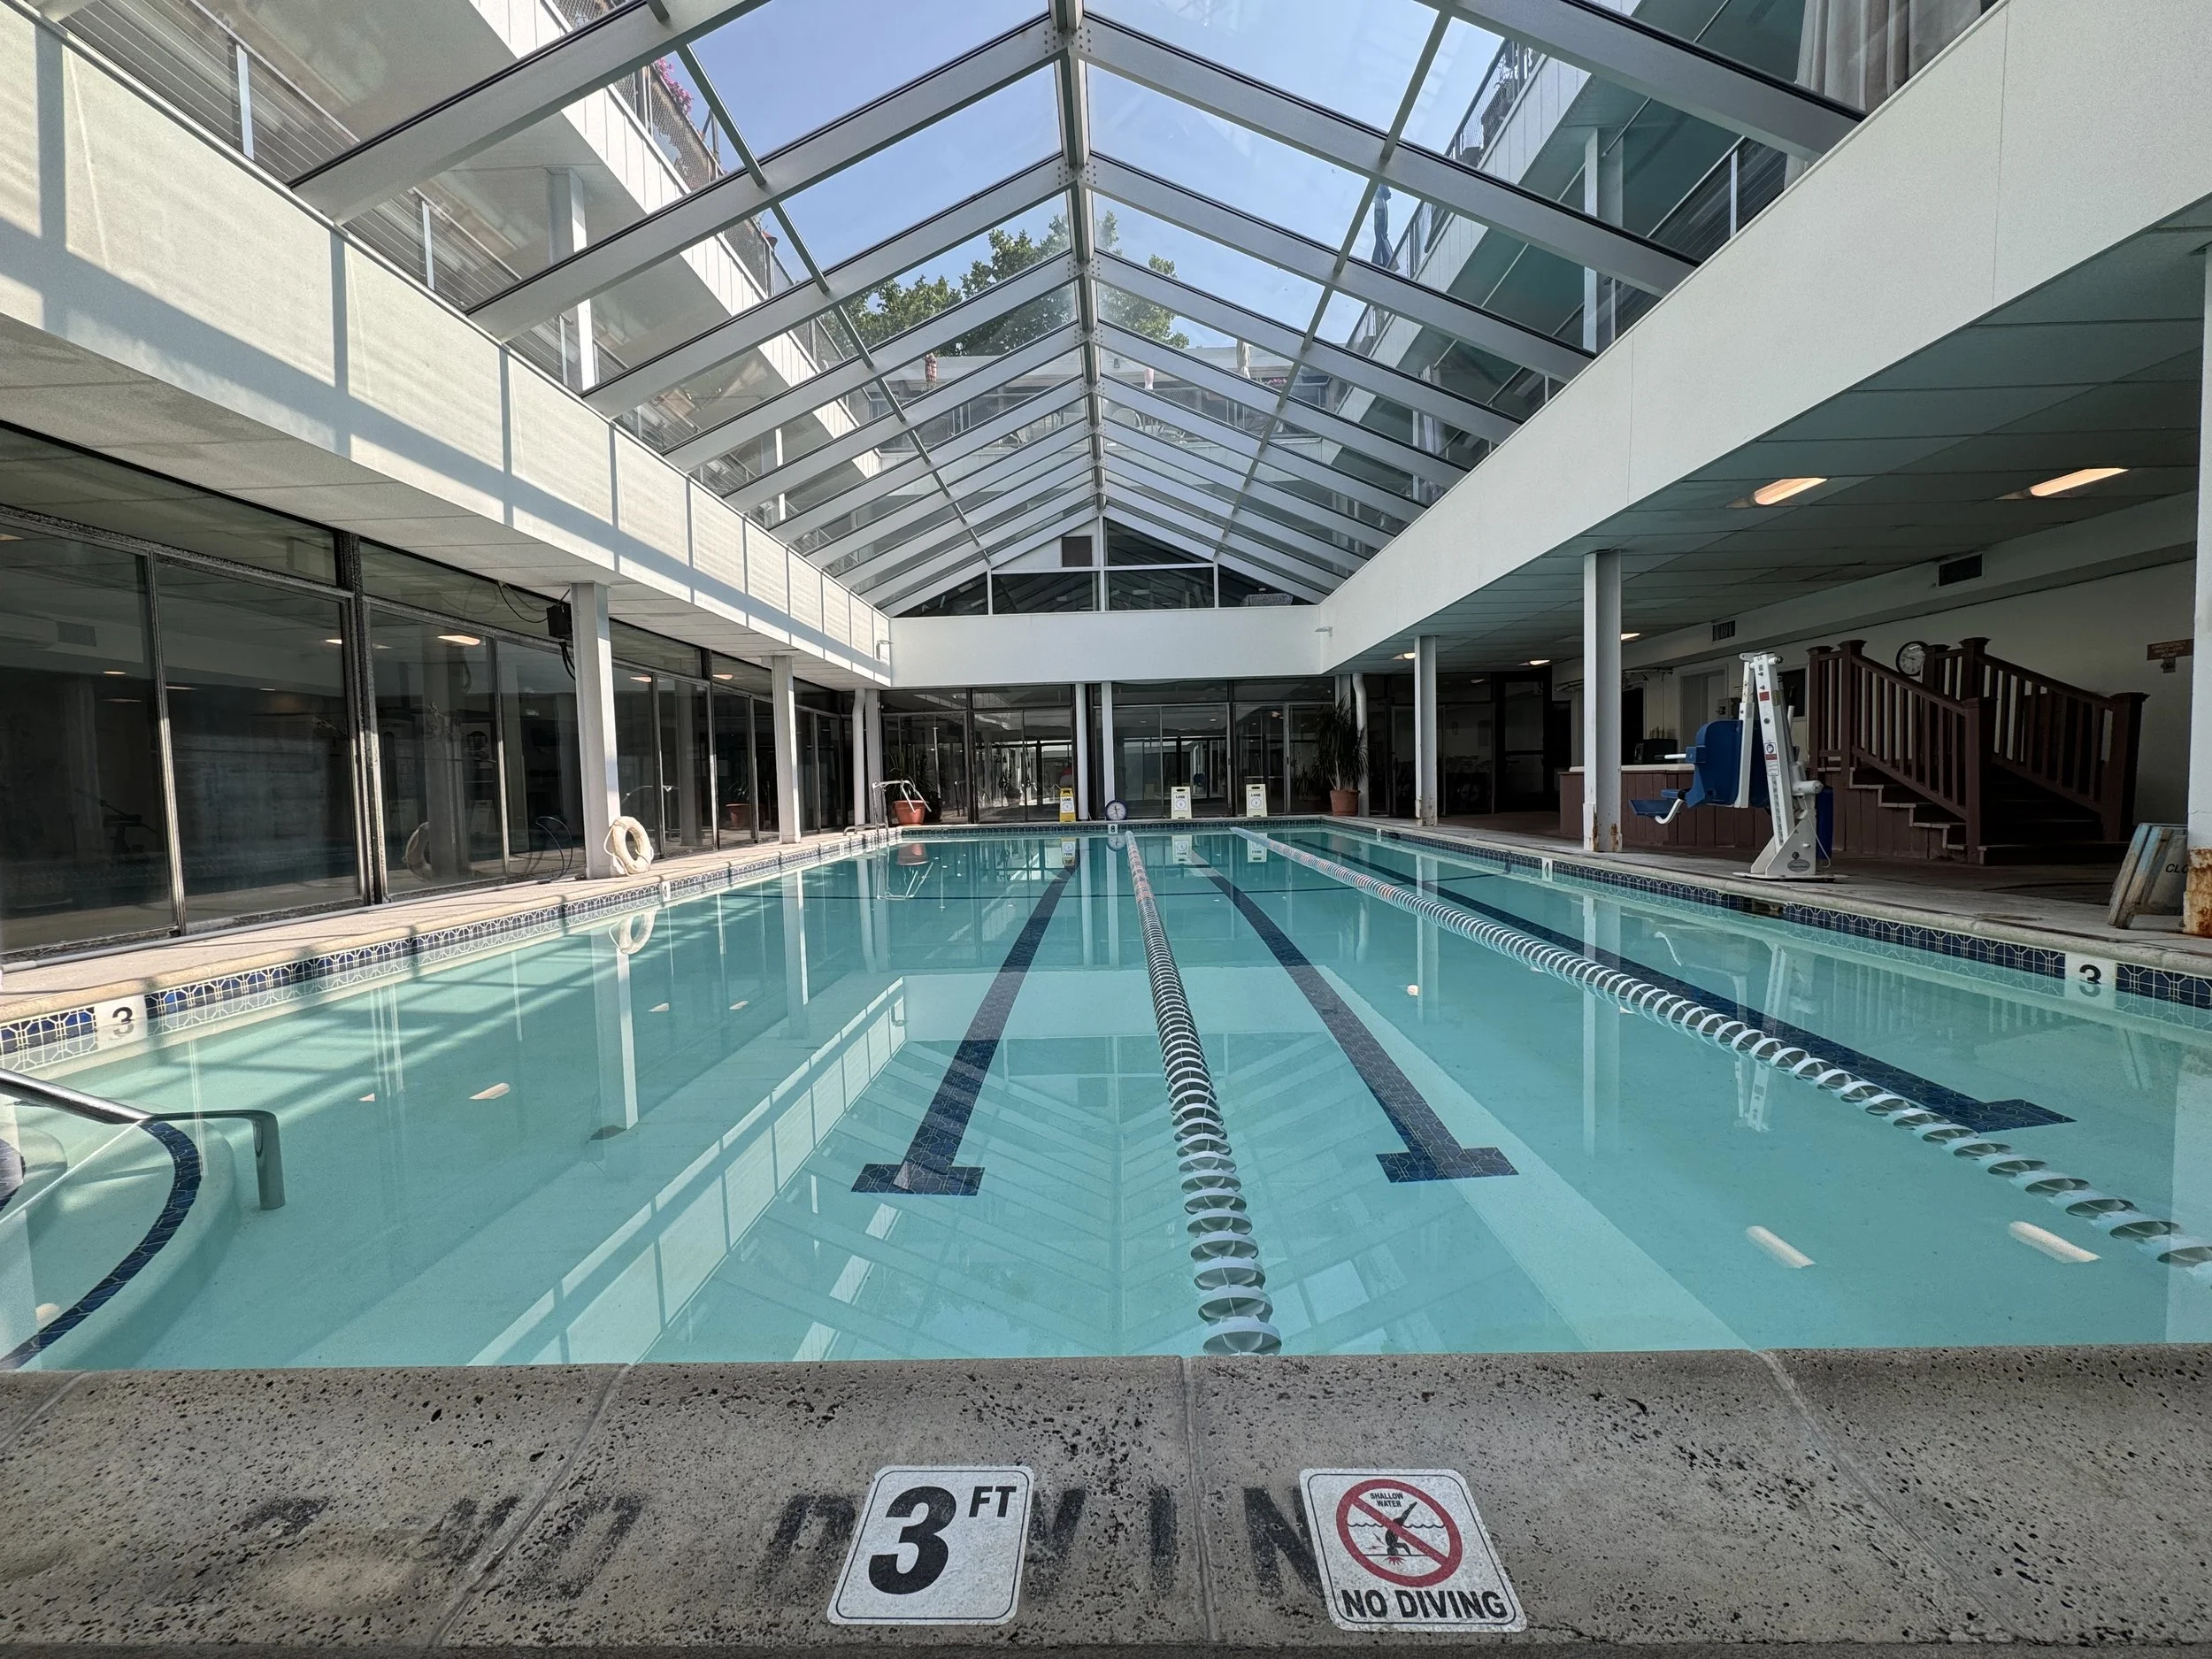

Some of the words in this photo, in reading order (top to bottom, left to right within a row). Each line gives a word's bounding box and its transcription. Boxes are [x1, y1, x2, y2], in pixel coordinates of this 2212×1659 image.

[2079, 964, 2101, 997] 3
[112, 1007, 134, 1035] 3
[869, 1486, 956, 1594] 3
[969, 1486, 1017, 1517] FT
[1341, 1589, 1388, 1618] NO
[1394, 1589, 1508, 1619] DIVING
